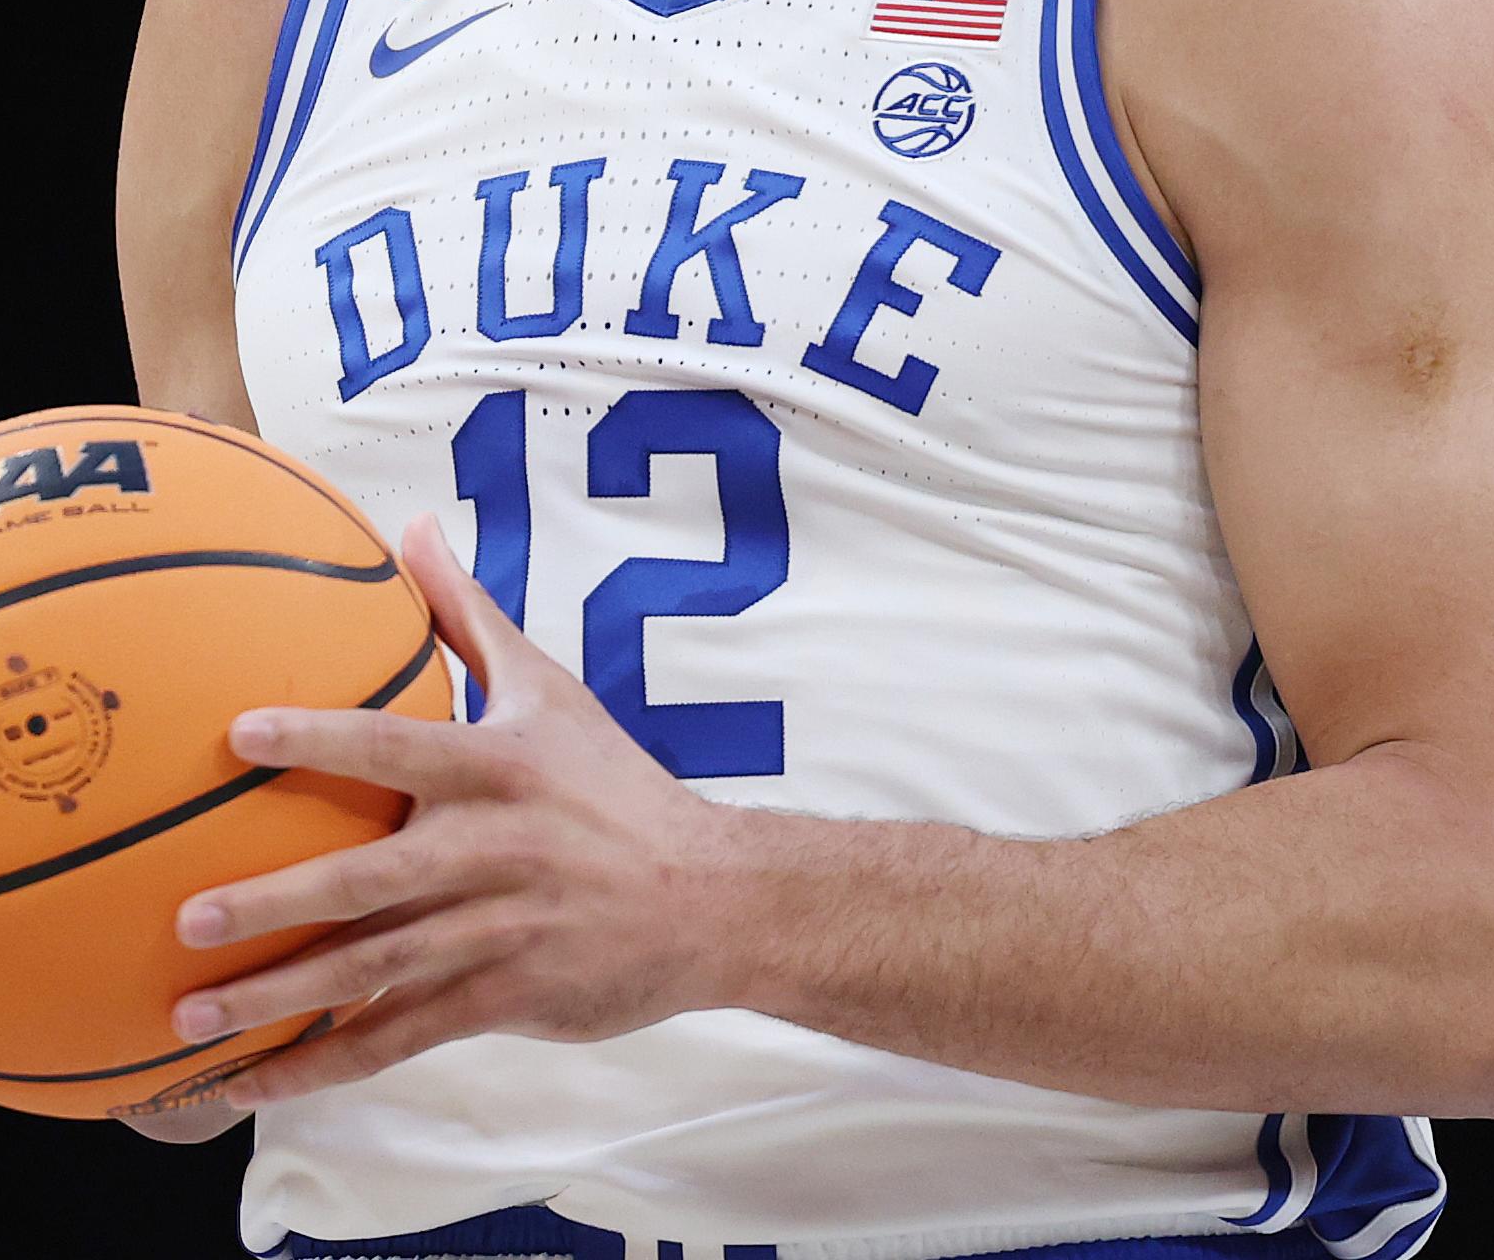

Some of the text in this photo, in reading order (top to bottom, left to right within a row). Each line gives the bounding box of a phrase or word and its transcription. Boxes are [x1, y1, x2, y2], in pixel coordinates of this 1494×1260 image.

[883, 92, 973, 117] ACC
[316, 158, 1000, 416] DUKE
[62, 500, 150, 517] BALL
[452, 389, 789, 779] 12
